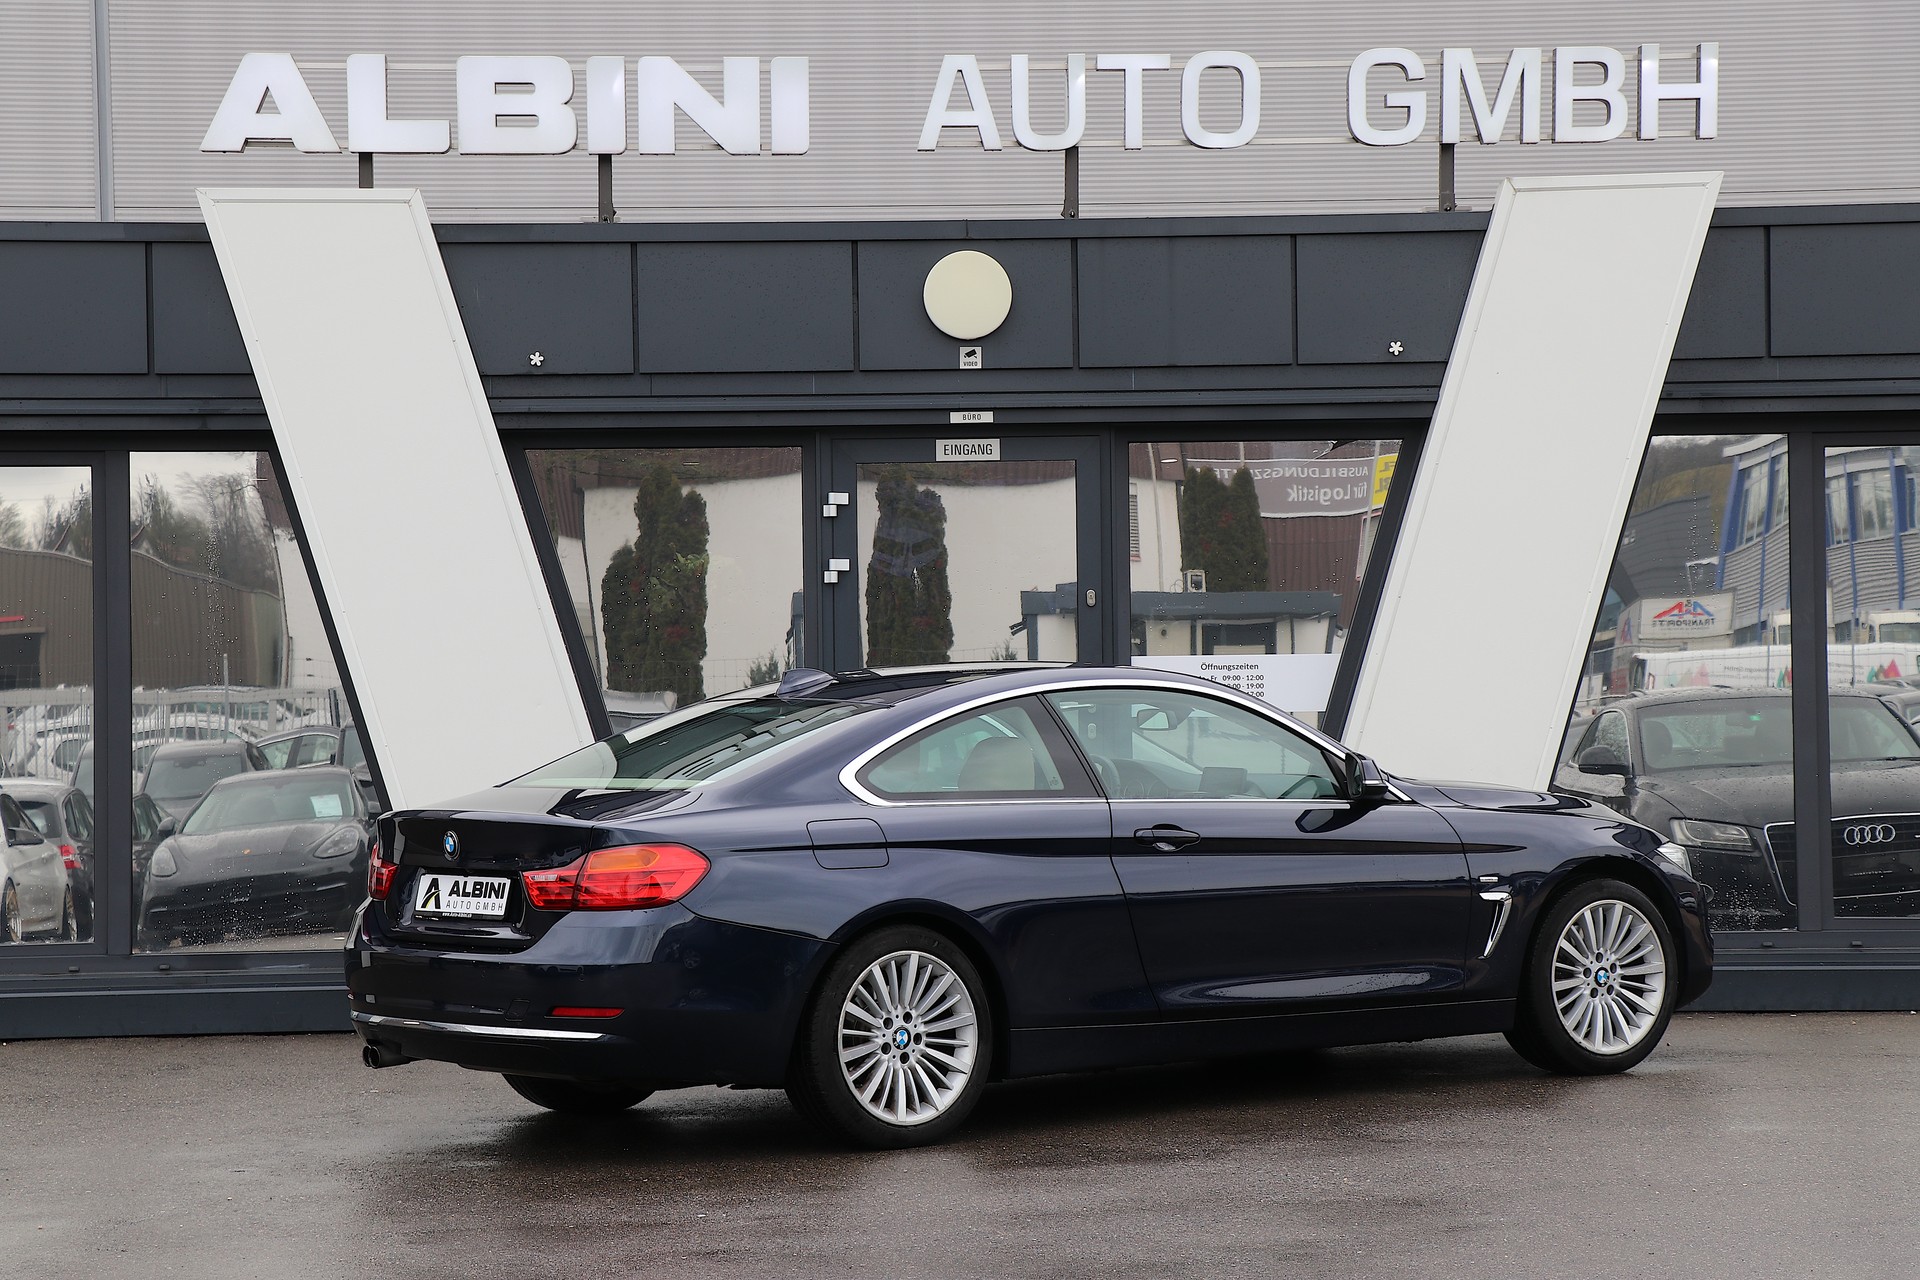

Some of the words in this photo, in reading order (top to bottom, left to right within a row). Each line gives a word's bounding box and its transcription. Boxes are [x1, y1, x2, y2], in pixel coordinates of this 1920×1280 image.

[199, 52, 810, 155] ALBINI
[917, 50, 1262, 152] AUTO
[1346, 42, 1720, 148] GMBH
[962, 413, 982, 421] BÜRO
[943, 443, 993, 456] EINGANG
[1200, 662, 1259, 671] Öffnungszeiten
[448, 881, 506, 899] ALBINI
[446, 900, 471, 910] AUTO
[475, 901, 504, 911] GMBH
